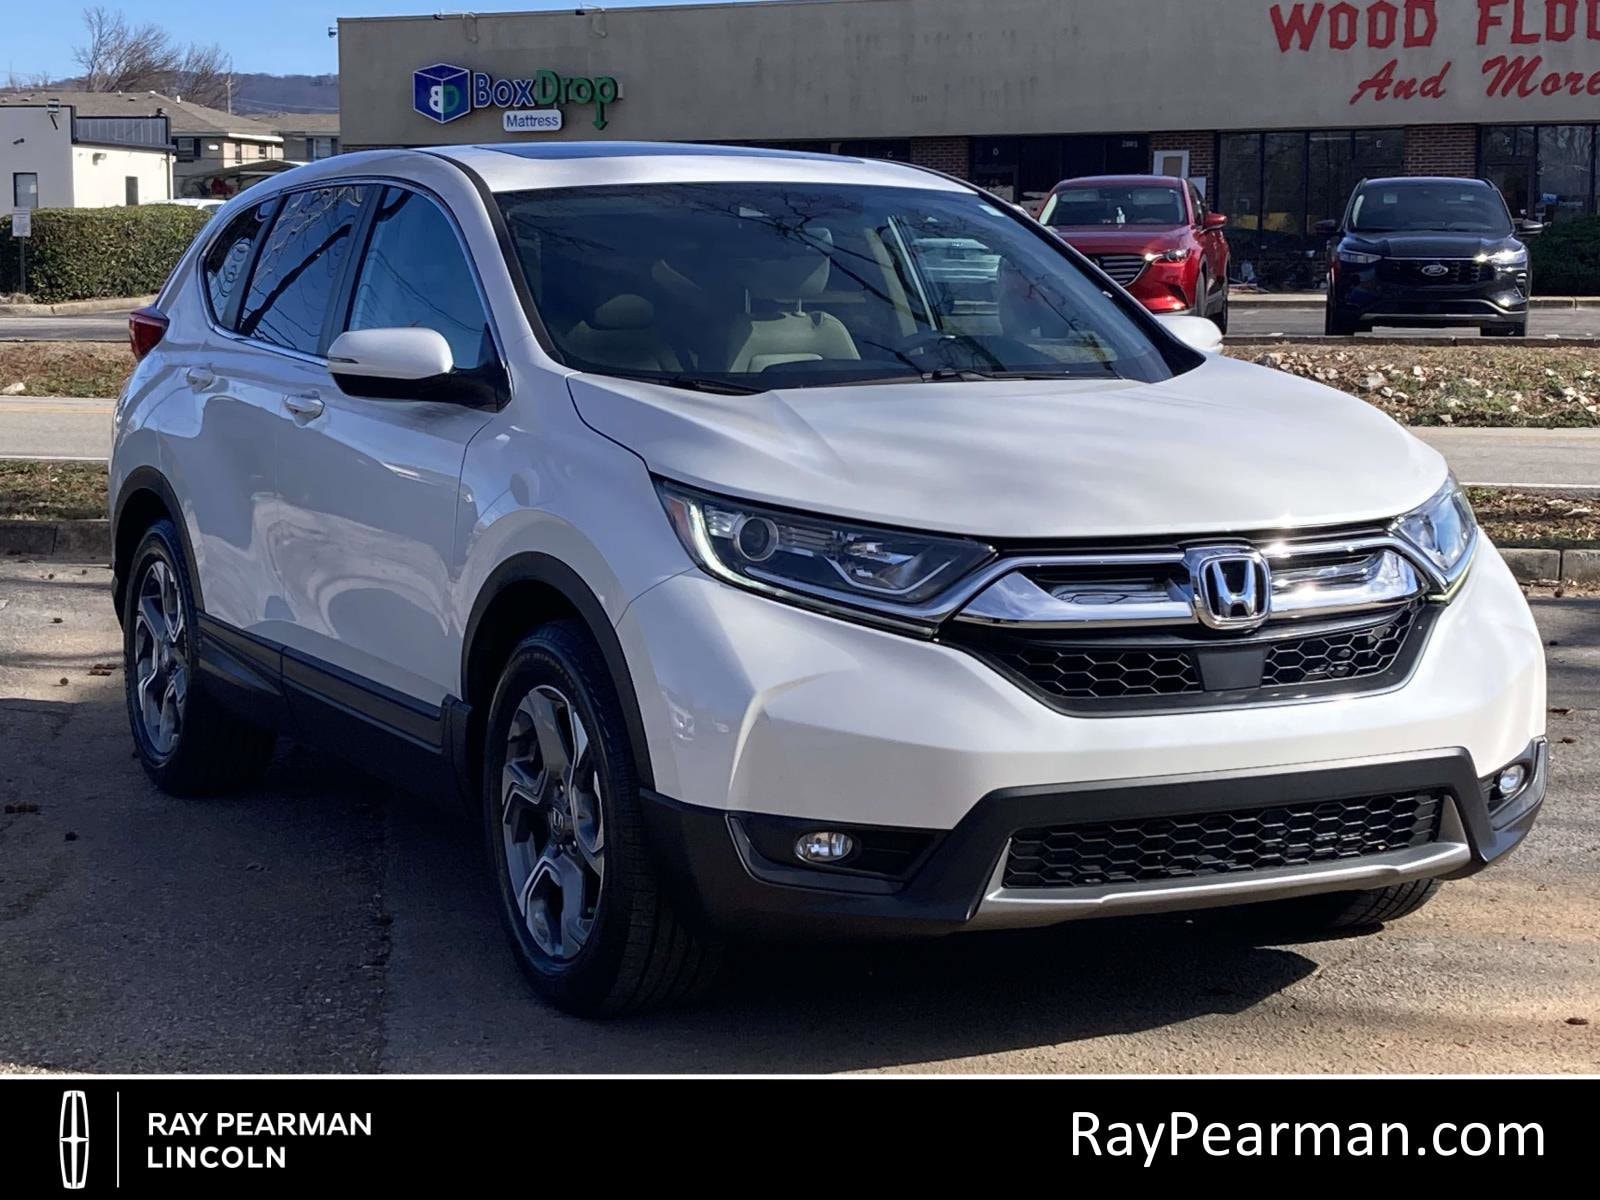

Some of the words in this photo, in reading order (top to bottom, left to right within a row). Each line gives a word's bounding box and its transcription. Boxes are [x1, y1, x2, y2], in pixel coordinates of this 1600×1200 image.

[1270, 0, 1438, 52] WOOD
[473, 69, 618, 130] BoxDrop
[1349, 58, 1451, 105] And
[1482, 54, 1600, 98] More
[506, 114, 559, 127] Mattress
